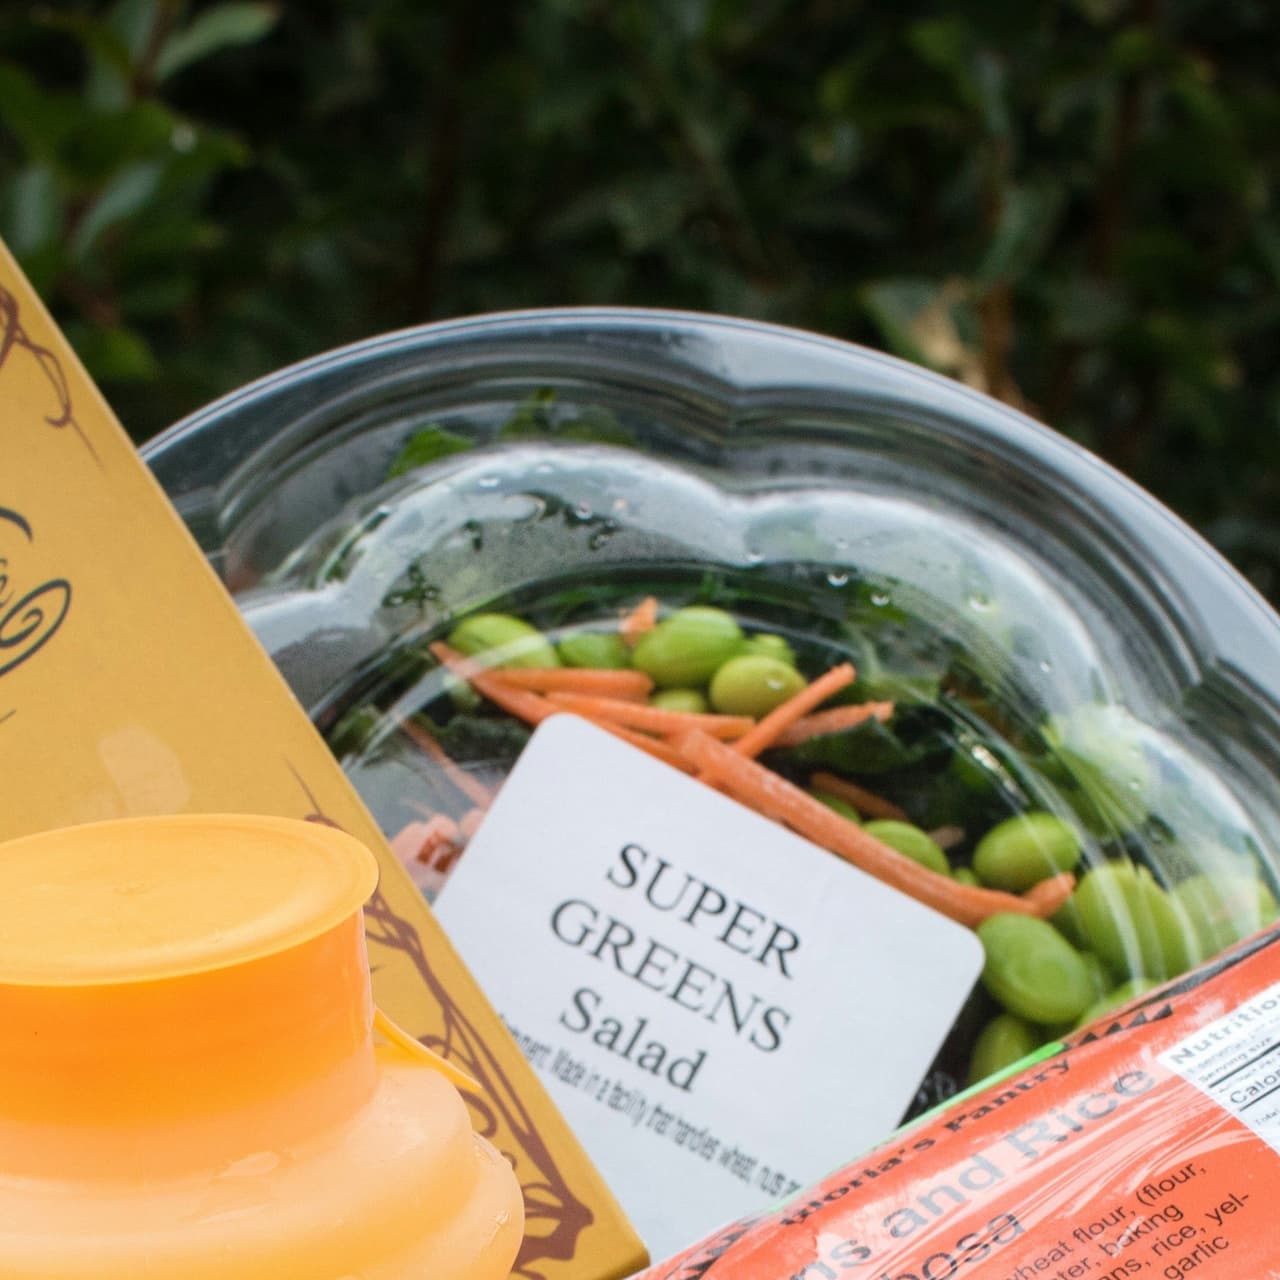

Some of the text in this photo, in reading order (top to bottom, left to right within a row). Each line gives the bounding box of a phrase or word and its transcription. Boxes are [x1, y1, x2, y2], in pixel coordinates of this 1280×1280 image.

[605, 841, 802, 981] SUPER
[549, 898, 792, 1056] GREENS
[559, 987, 707, 1093] Salad
[944, 1058, 1071, 1132] Pantry
[882, 1154, 1006, 1239] and
[1004, 1067, 1155, 1160] Rice
[1072, 1204, 1137, 1244] flour,
[1135, 1162, 1207, 1207] (flour,
[1098, 1203, 1184, 1258] baking
[1151, 1223, 1207, 1257] rice,
[1205, 1192, 1250, 1227] yel-
